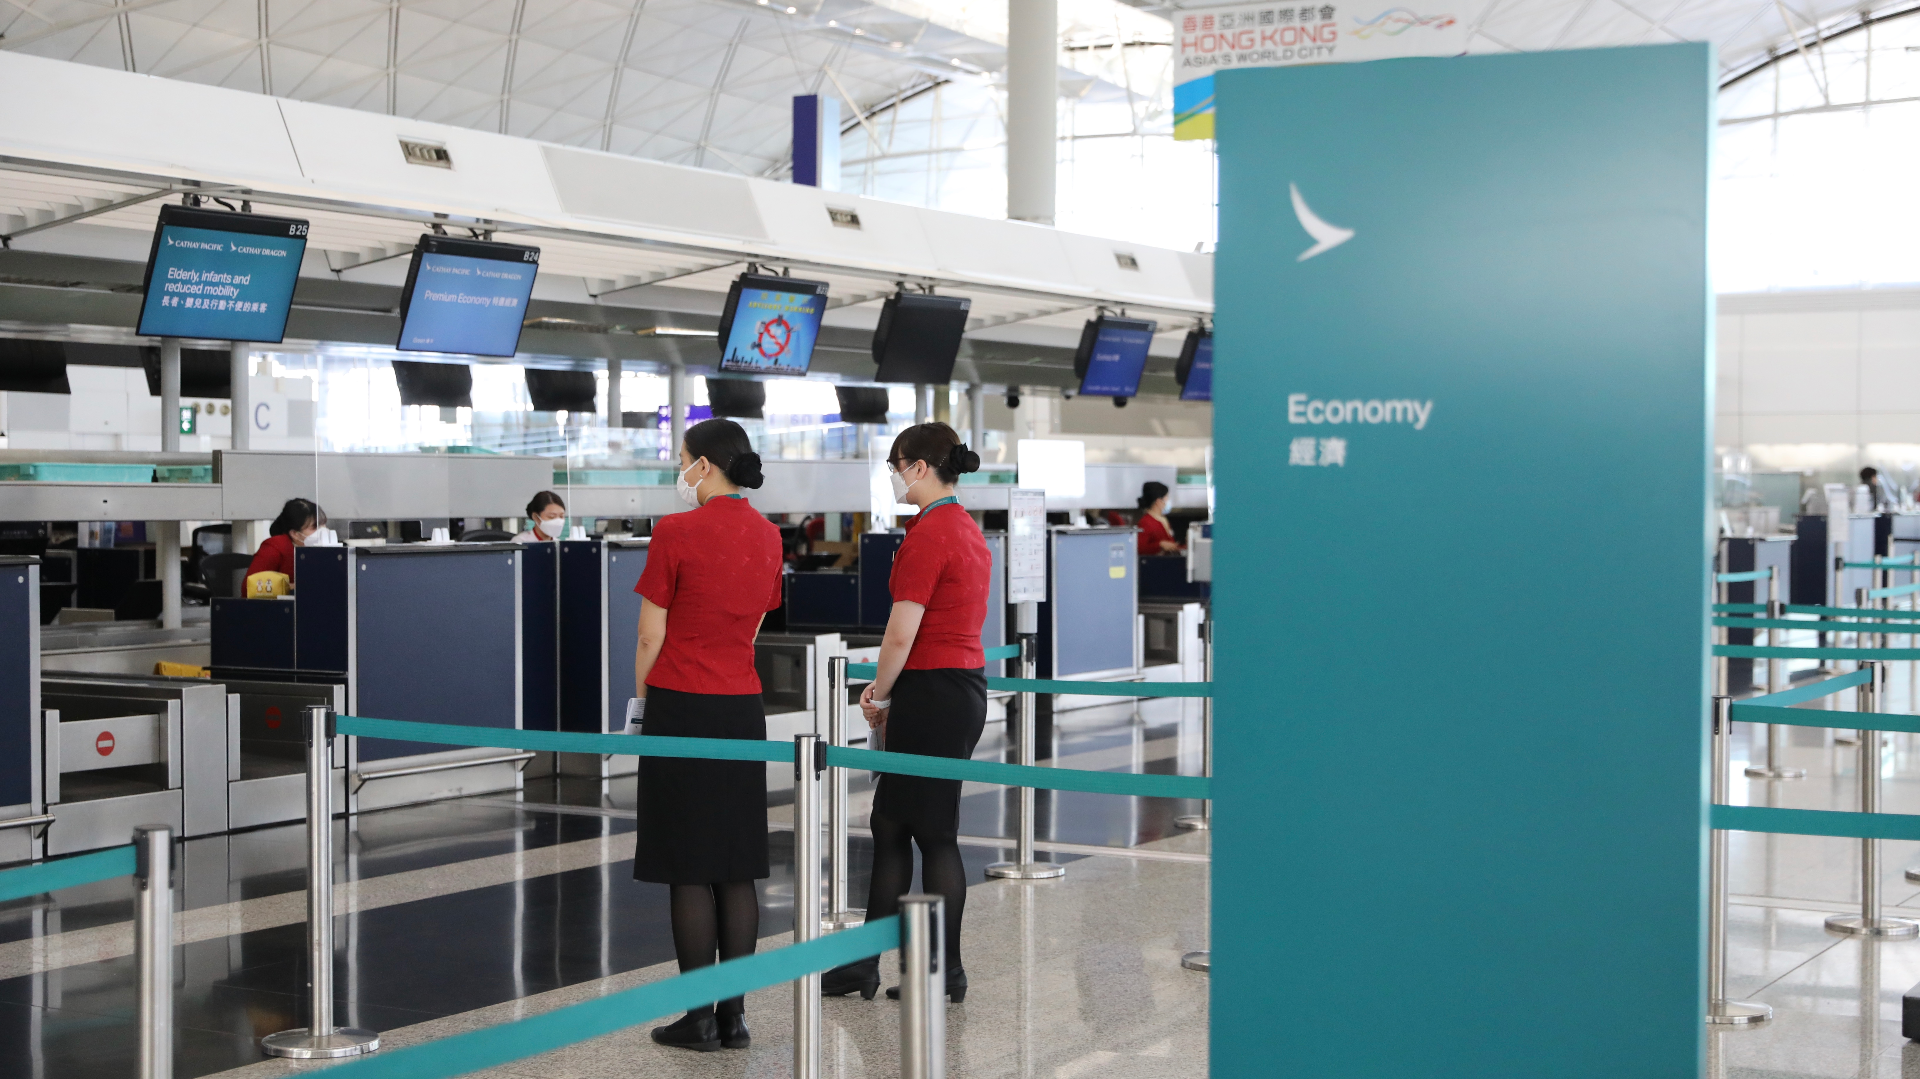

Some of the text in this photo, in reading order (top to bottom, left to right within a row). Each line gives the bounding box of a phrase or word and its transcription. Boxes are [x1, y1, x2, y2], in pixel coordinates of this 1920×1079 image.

[1181, 22, 1338, 54] HONG KONG
[1182, 45, 1337, 68] ASIA'S WORLD CITY
[289, 224, 308, 236] B25
[175, 239, 224, 251] CATHAY PACIFIC
[238, 246, 287, 257] CATHAY DRAGON
[523, 251, 539, 262] B24
[168, 267, 251, 285] Elderly, infants and
[164, 282, 239, 298] reduced mobility
[424, 289, 457, 303] Premium
[458, 293, 491, 307] Economy
[255, 402, 270, 431] C
[1287, 393, 1434, 430] Economy
